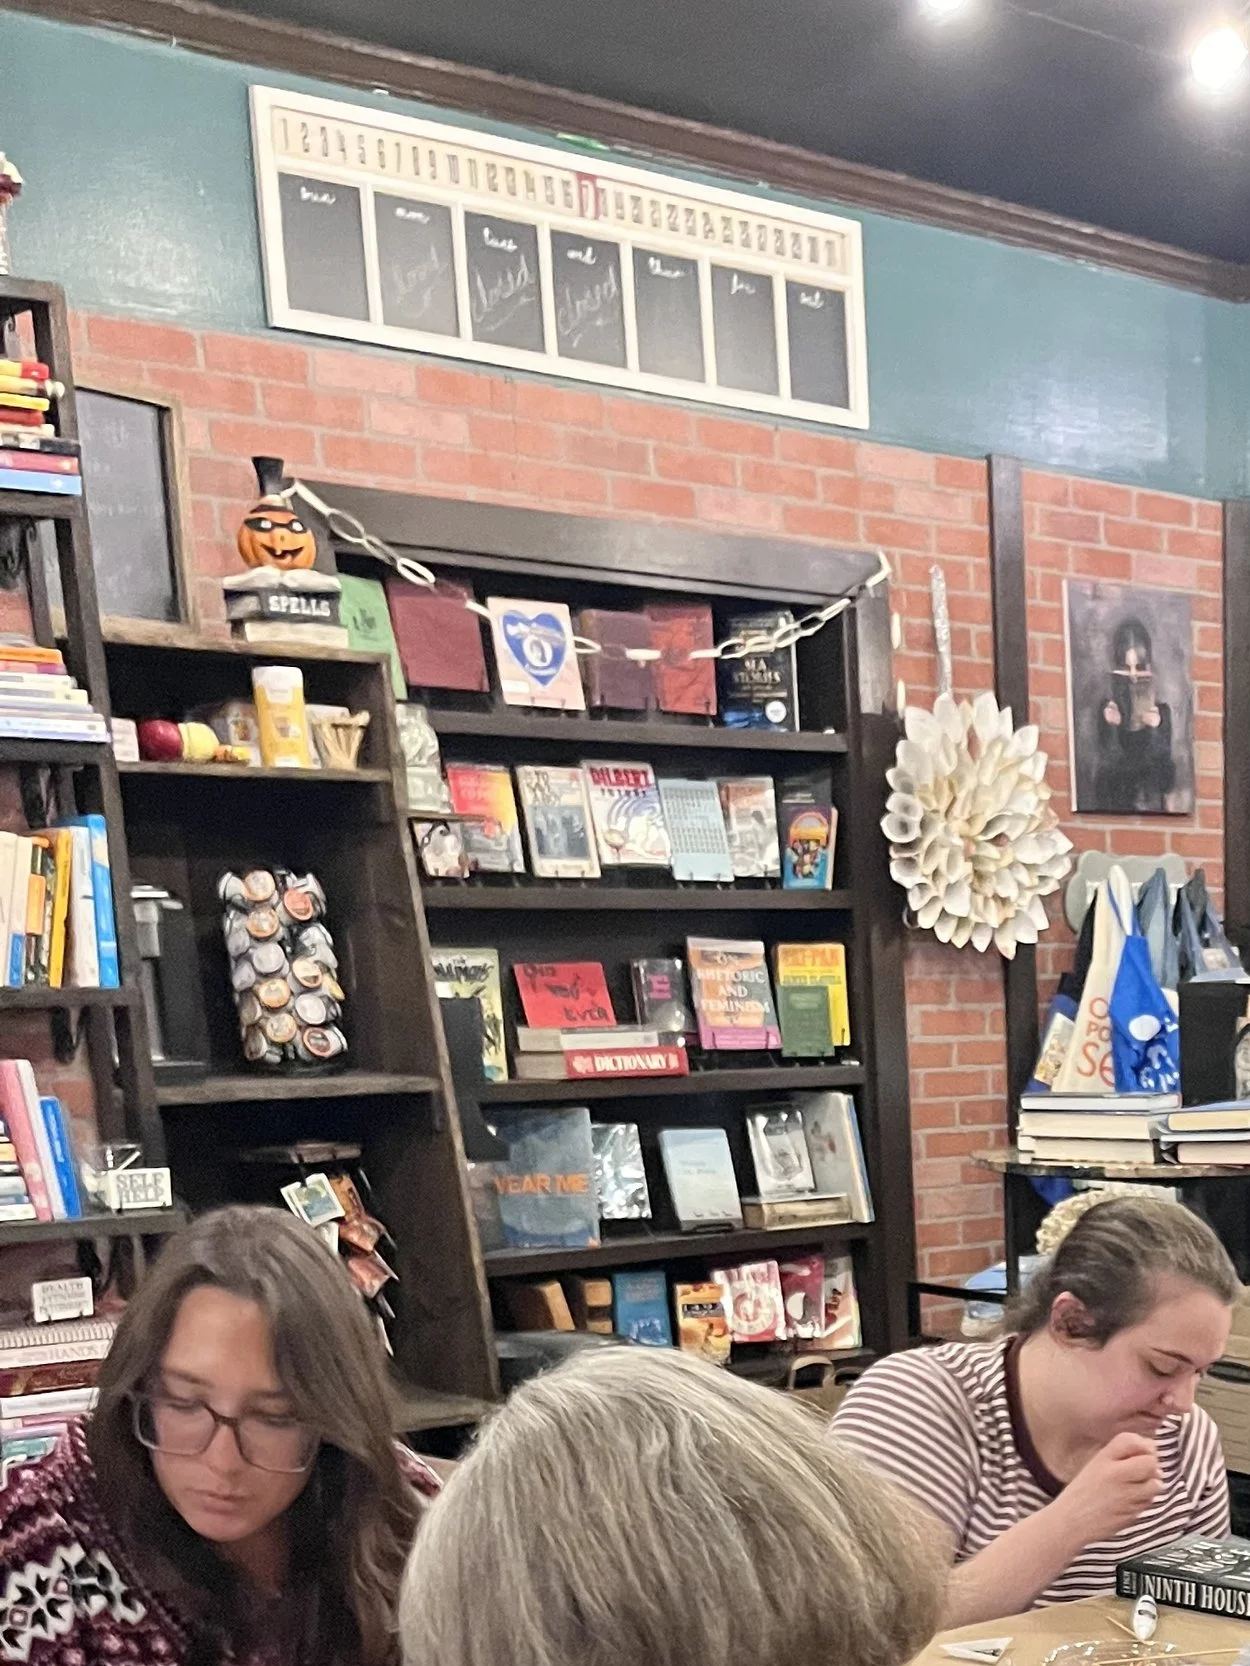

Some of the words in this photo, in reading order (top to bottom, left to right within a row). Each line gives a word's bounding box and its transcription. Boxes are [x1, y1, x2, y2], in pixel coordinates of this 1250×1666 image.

[281, 118, 289, 150] 1
[300, 122, 310, 153] 2
[320, 126, 329, 157] 3
[337, 129, 347, 162] 4
[357, 135, 366, 164] 5
[377, 139, 386, 169] 6
[395, 142, 402, 172] 7
[412, 146, 420, 176] 8
[429, 150, 437, 180] 9
[447, 154, 459, 184] 10
[468, 159, 478, 189] 11
[269, 595, 330, 616] SPELLS
[589, 766, 651, 789] DILBERT
[697, 970, 766, 984] RHETORIC
[717, 986, 749, 998] AND
[563, 1004, 610, 1022] EVER
[702, 1000, 770, 1014] FEMINISM
[594, 1054, 669, 1073] DICTIONARY
[116, 1172, 165, 1189] SELF
[554, 1171, 590, 1194] ME
[118, 1185, 165, 1203] HELP
[1142, 1574, 1197, 1607] NINTH
